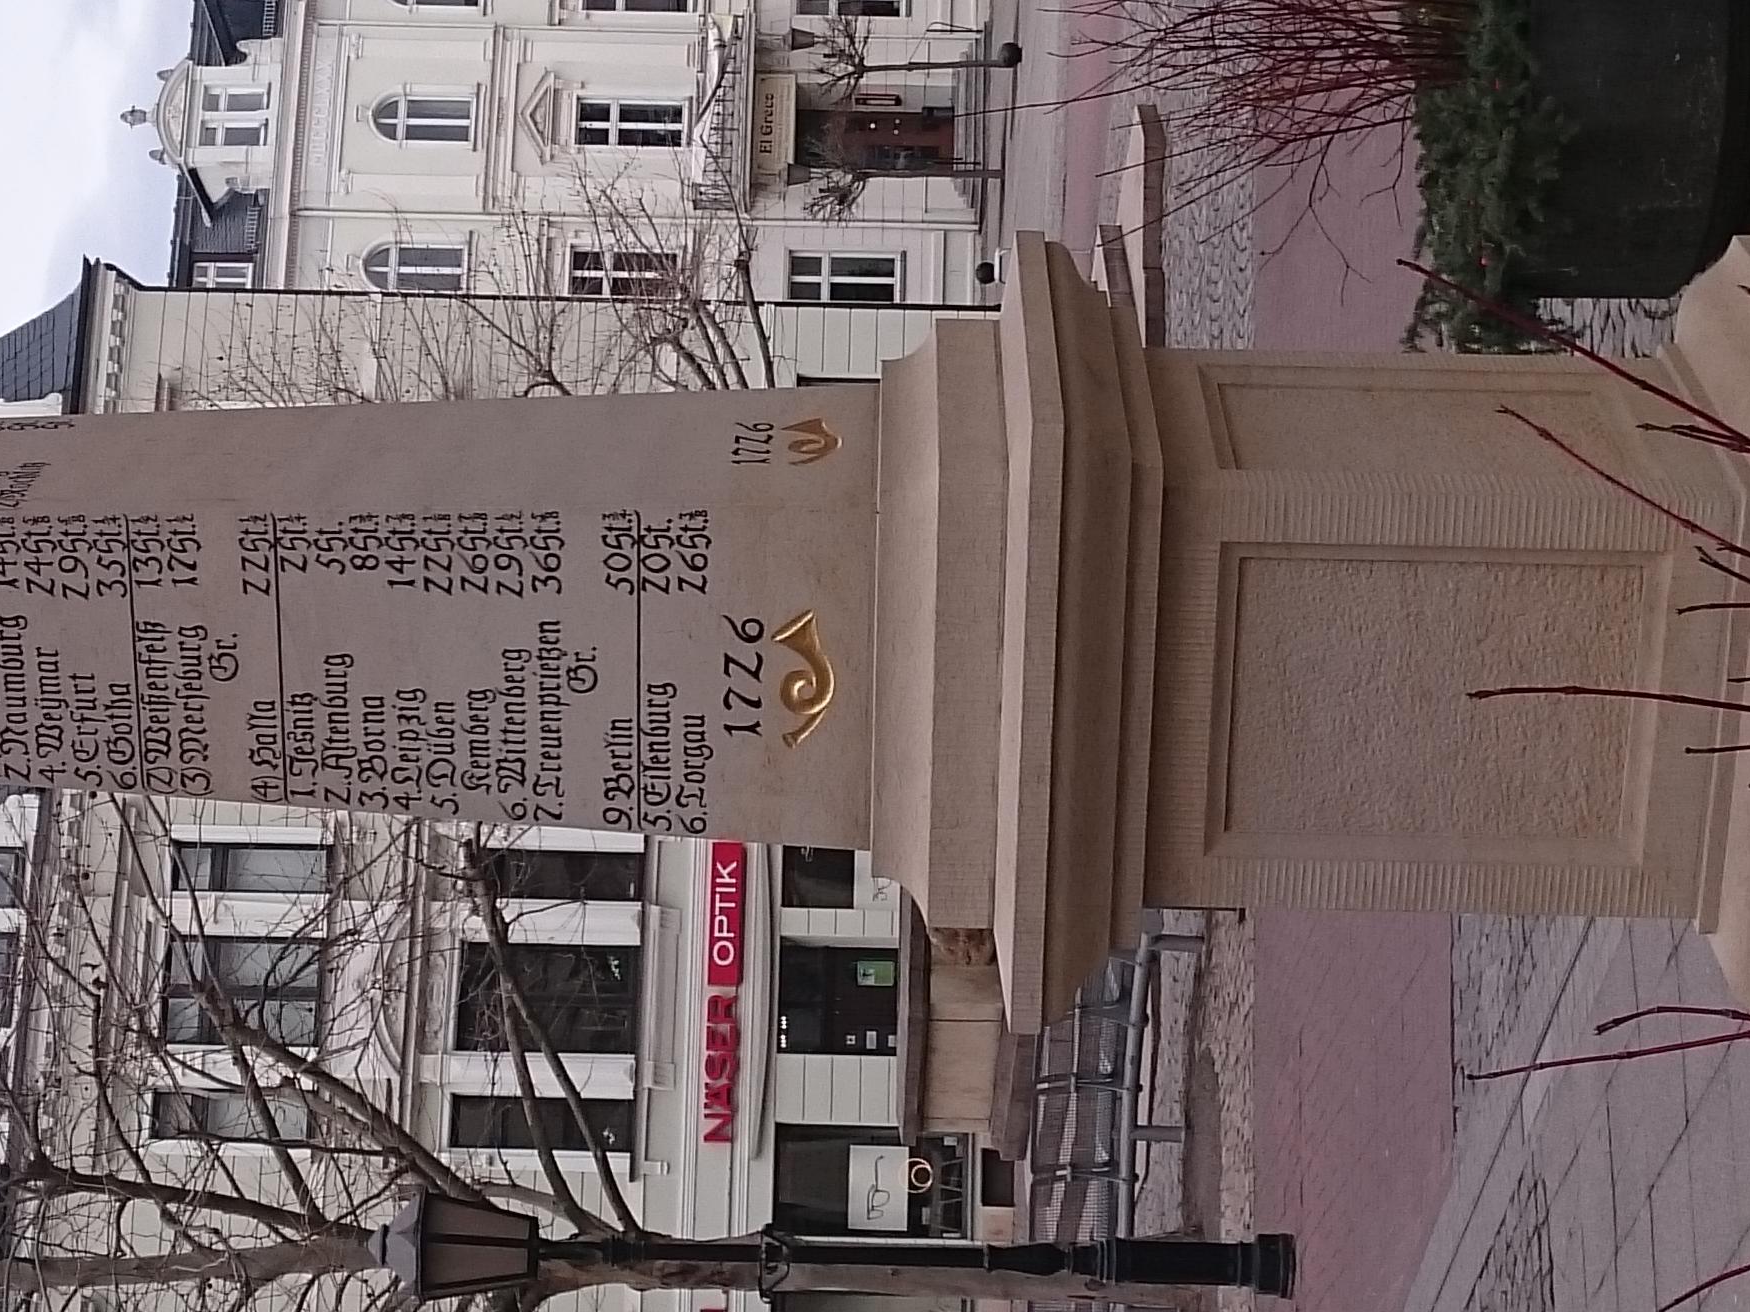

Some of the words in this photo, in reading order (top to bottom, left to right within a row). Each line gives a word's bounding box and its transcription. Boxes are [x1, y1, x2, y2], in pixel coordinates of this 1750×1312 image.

[759, 140, 773, 153] El
[731, 422, 774, 464] 1726
[721, 614, 765, 737] 1726
[713, 860, 738, 966] OPTIK
[703, 994, 740, 1143] NÄSER
